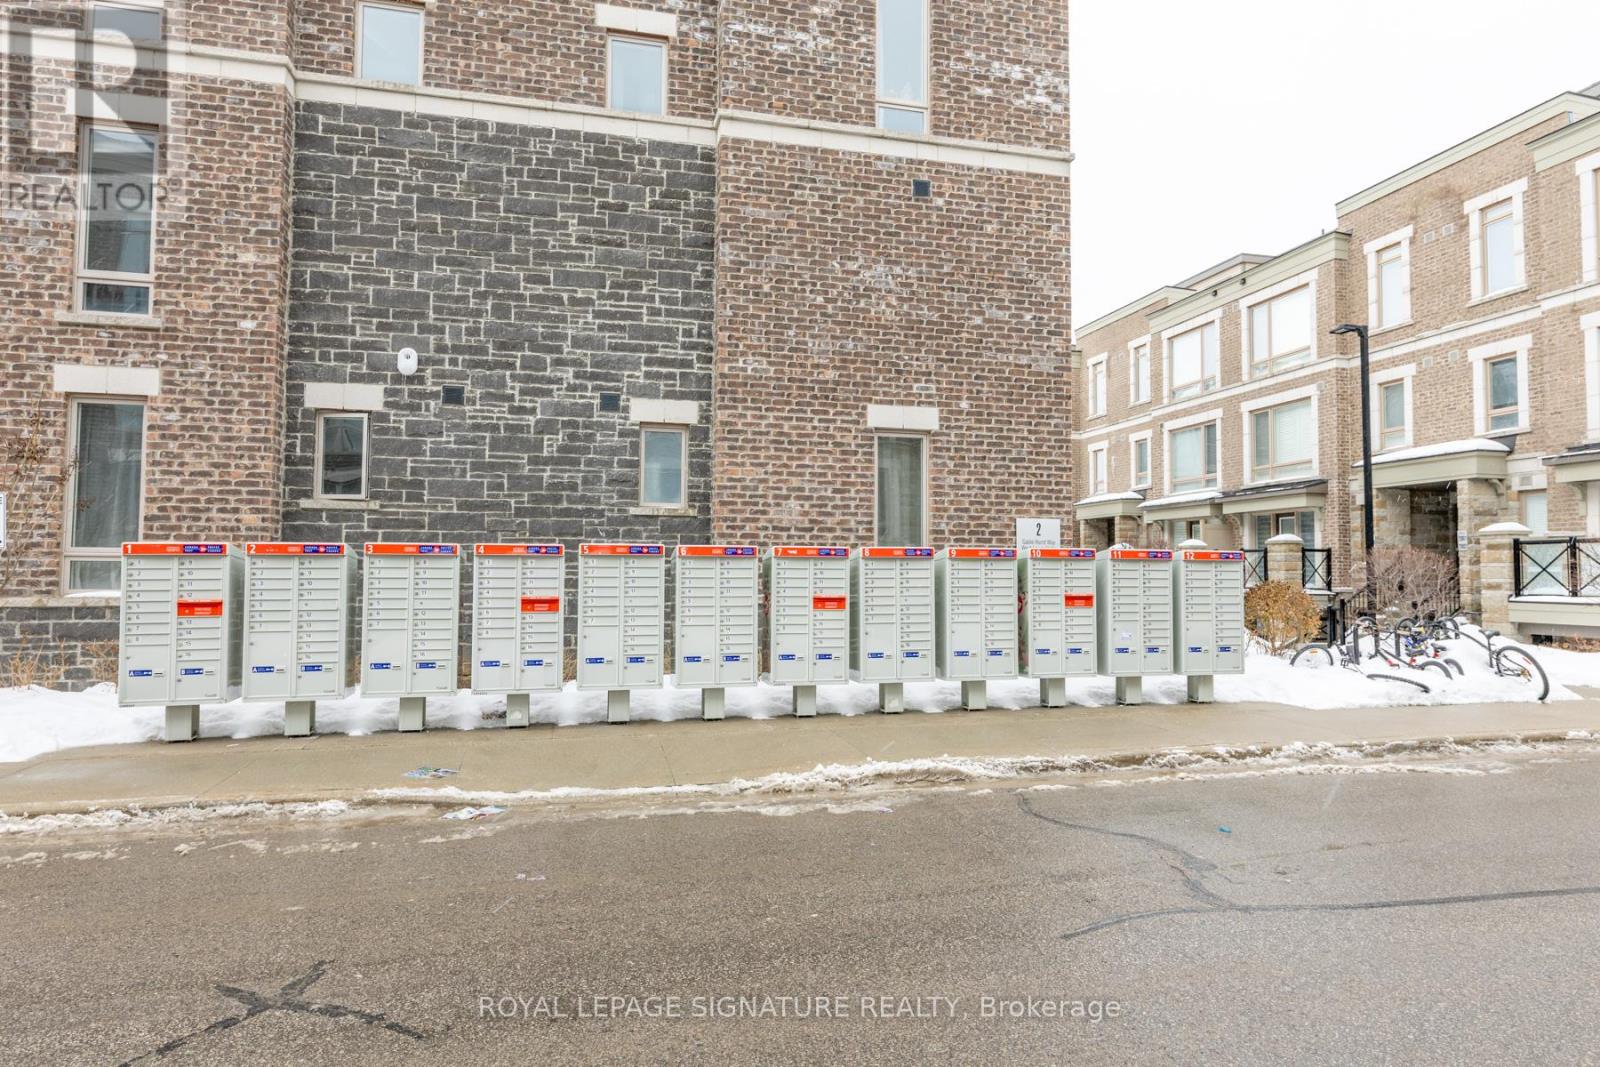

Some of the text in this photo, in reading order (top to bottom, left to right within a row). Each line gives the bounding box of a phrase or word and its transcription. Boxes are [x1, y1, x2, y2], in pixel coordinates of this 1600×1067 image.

[1036, 522, 1042, 536] 2
[127, 544, 132, 554] 1
[249, 544, 256, 554] 2
[367, 544, 373, 554] 3
[478, 546, 484, 554] 4
[583, 546, 588, 554] 5
[680, 546, 686, 556] 6
[777, 548, 782, 556] 7
[864, 548, 870, 556] 8
[951, 550, 956, 558] 9
[1113, 550, 1121, 558] 11
